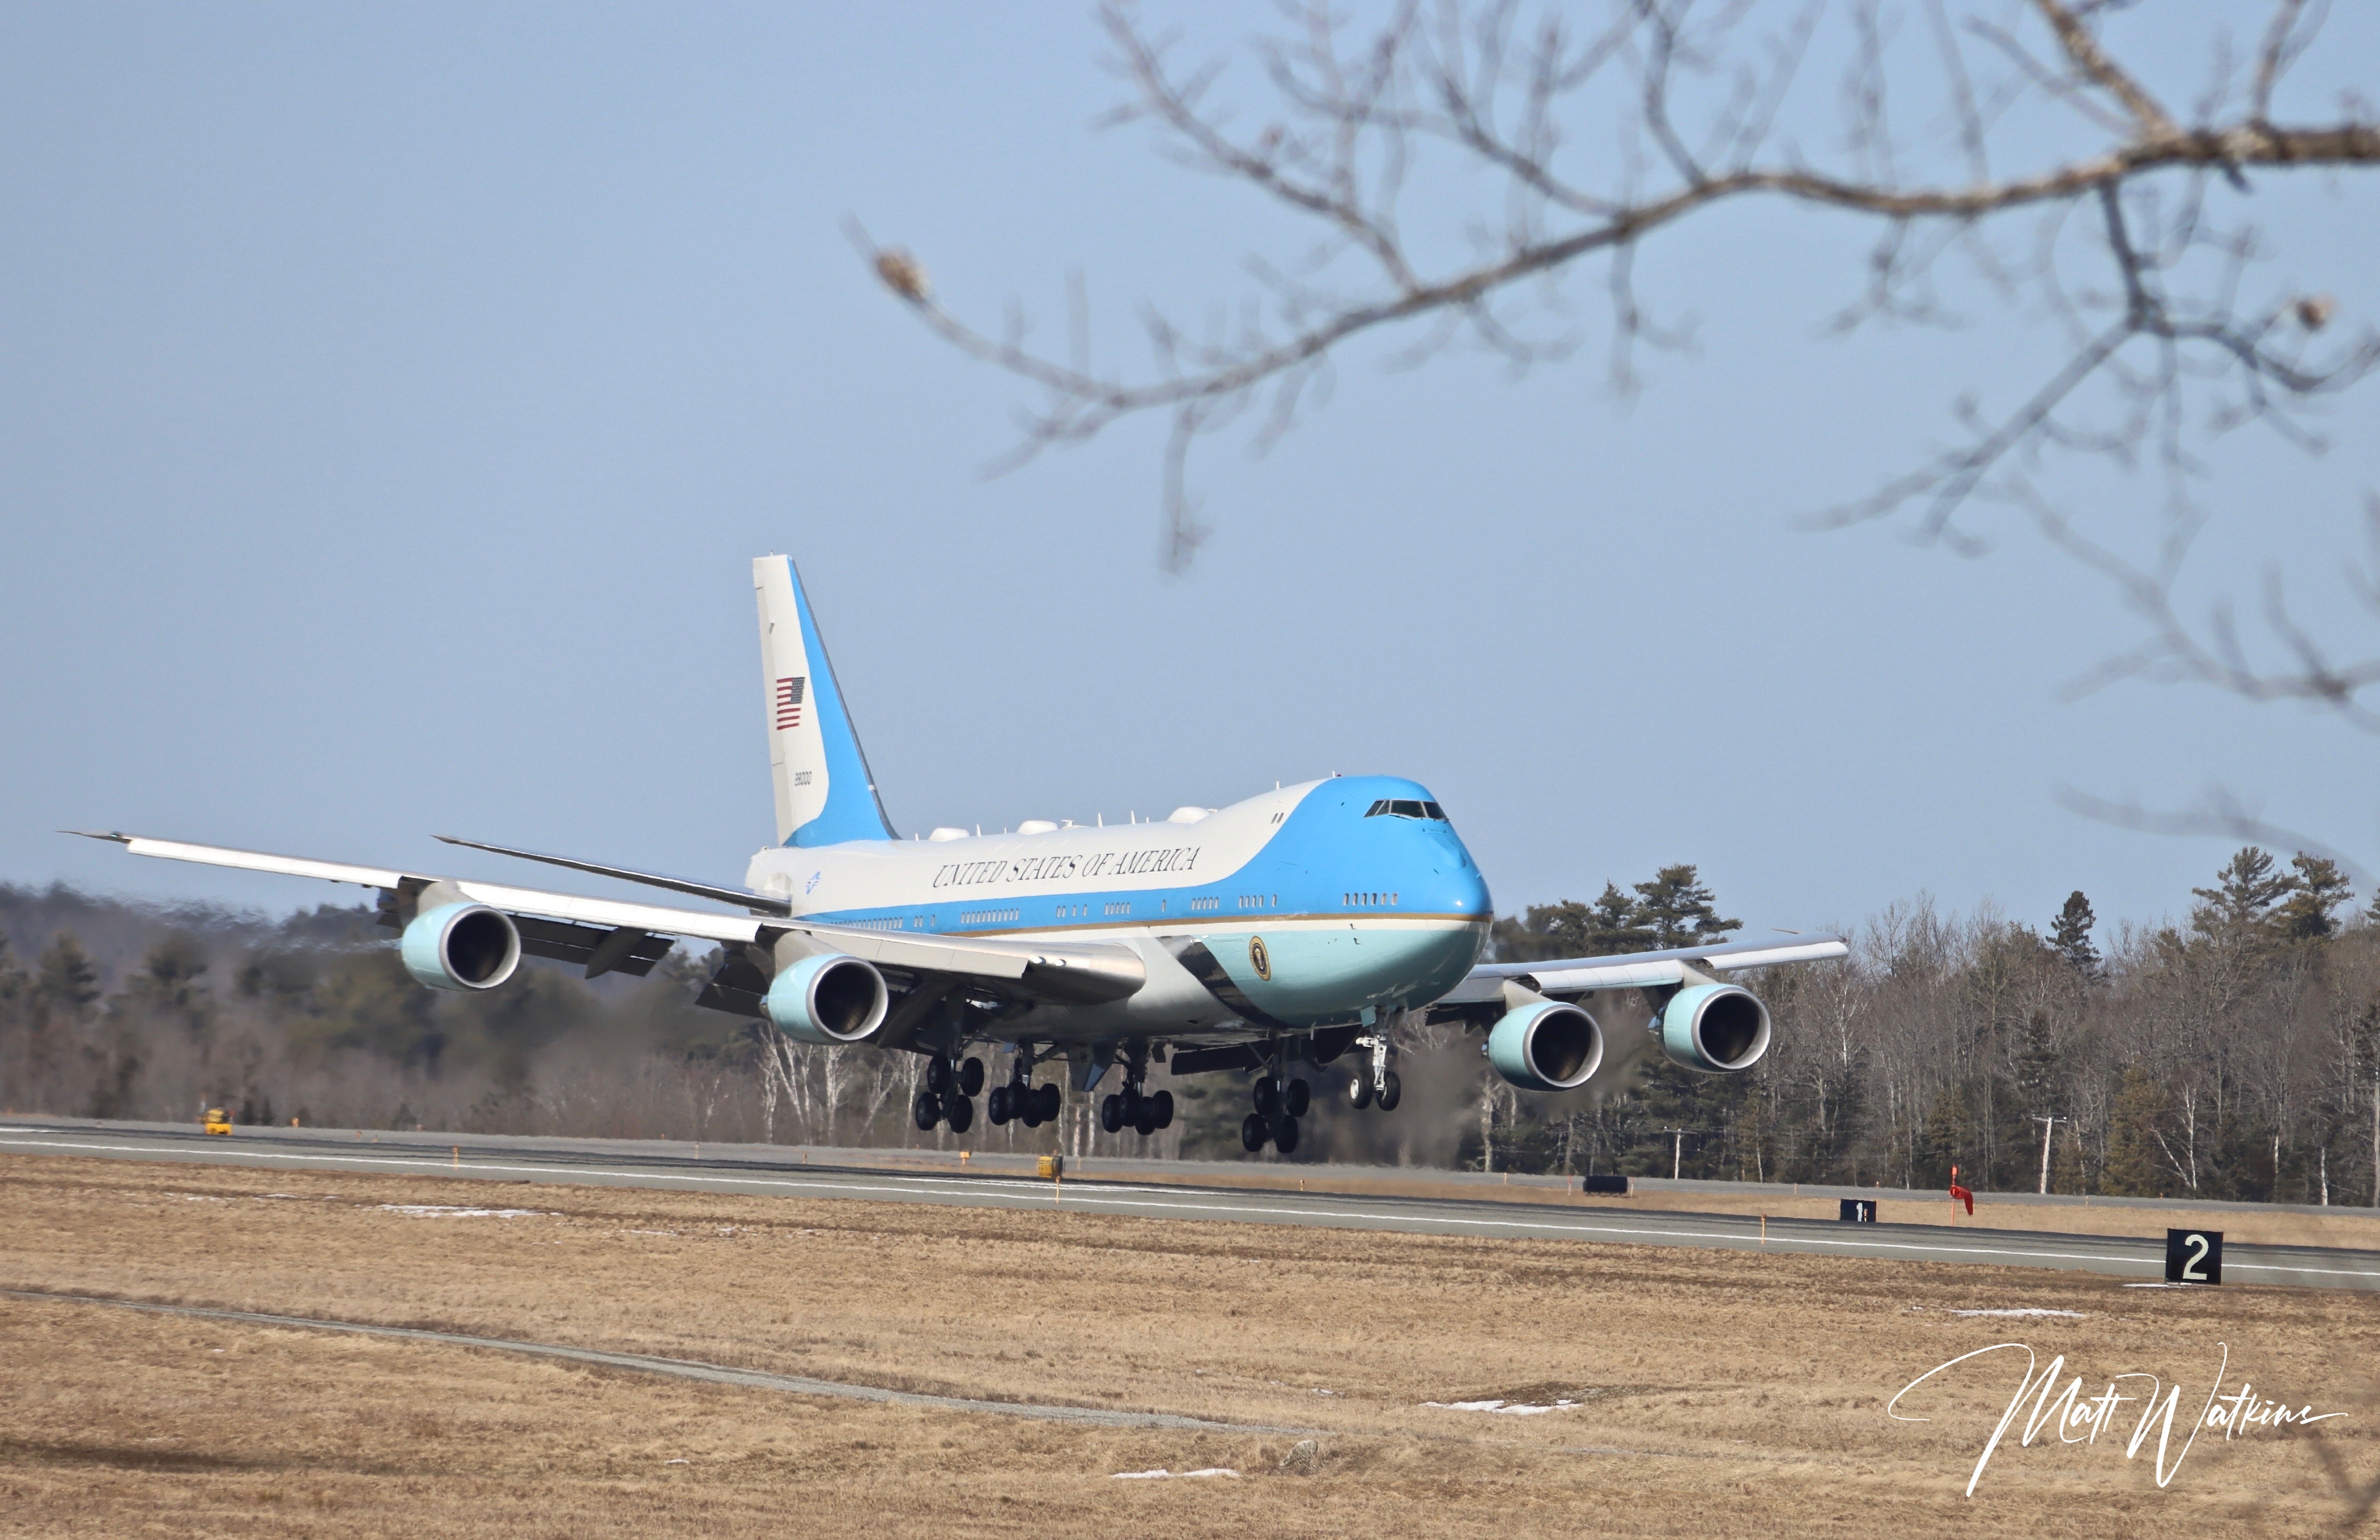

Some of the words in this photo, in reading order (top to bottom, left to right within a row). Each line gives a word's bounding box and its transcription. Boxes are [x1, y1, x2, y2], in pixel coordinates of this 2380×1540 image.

[933, 861, 1007, 888] UNITED
[1006, 856, 1083, 882] STATES
[1082, 853, 1115, 877] OF
[1107, 847, 1201, 875] AMERICA
[1856, 1202, 1863, 1222] 1
[2182, 1234, 2209, 1280] 2
